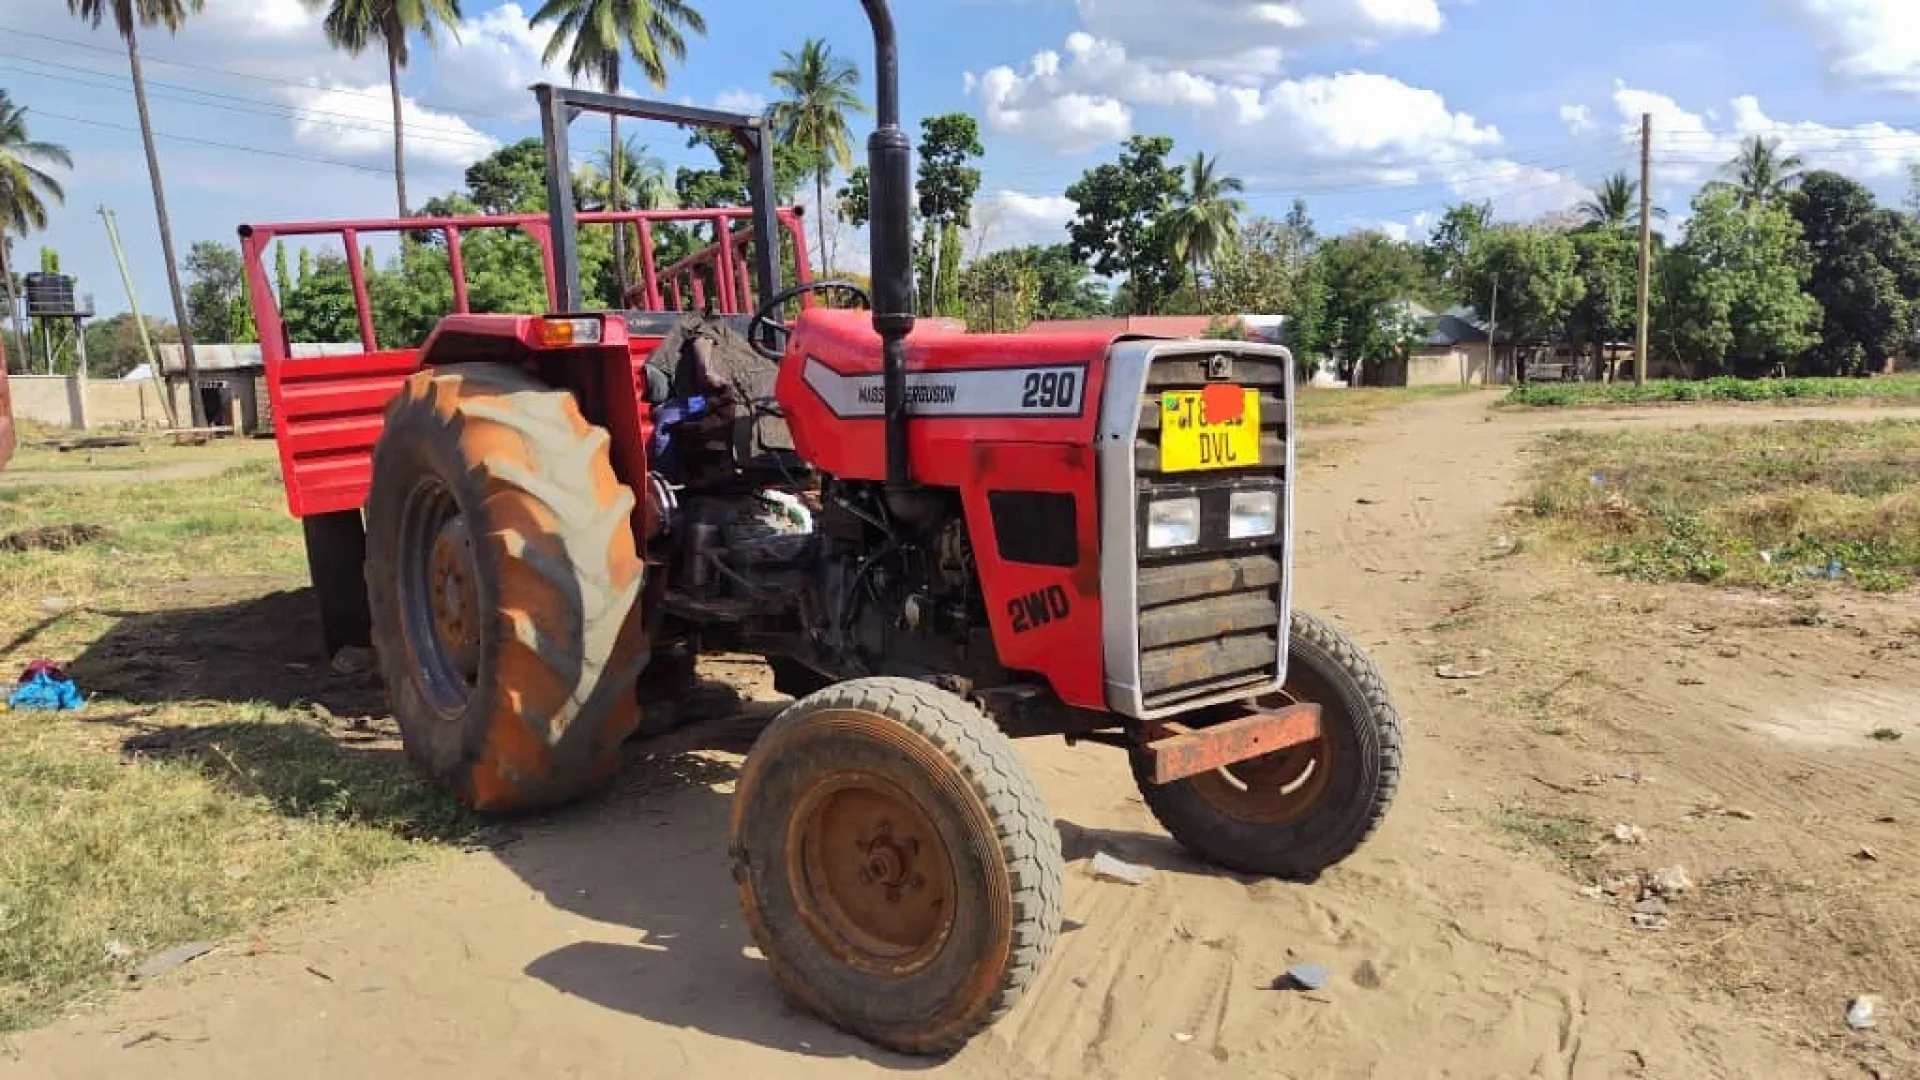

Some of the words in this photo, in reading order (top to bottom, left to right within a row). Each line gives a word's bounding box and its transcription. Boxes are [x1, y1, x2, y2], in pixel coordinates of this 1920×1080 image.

[858, 385, 886, 404] MASS
[902, 384, 957, 404] ERGUSON
[1022, 372, 1075, 408] 290
[1007, 584, 1069, 634] 2WD
